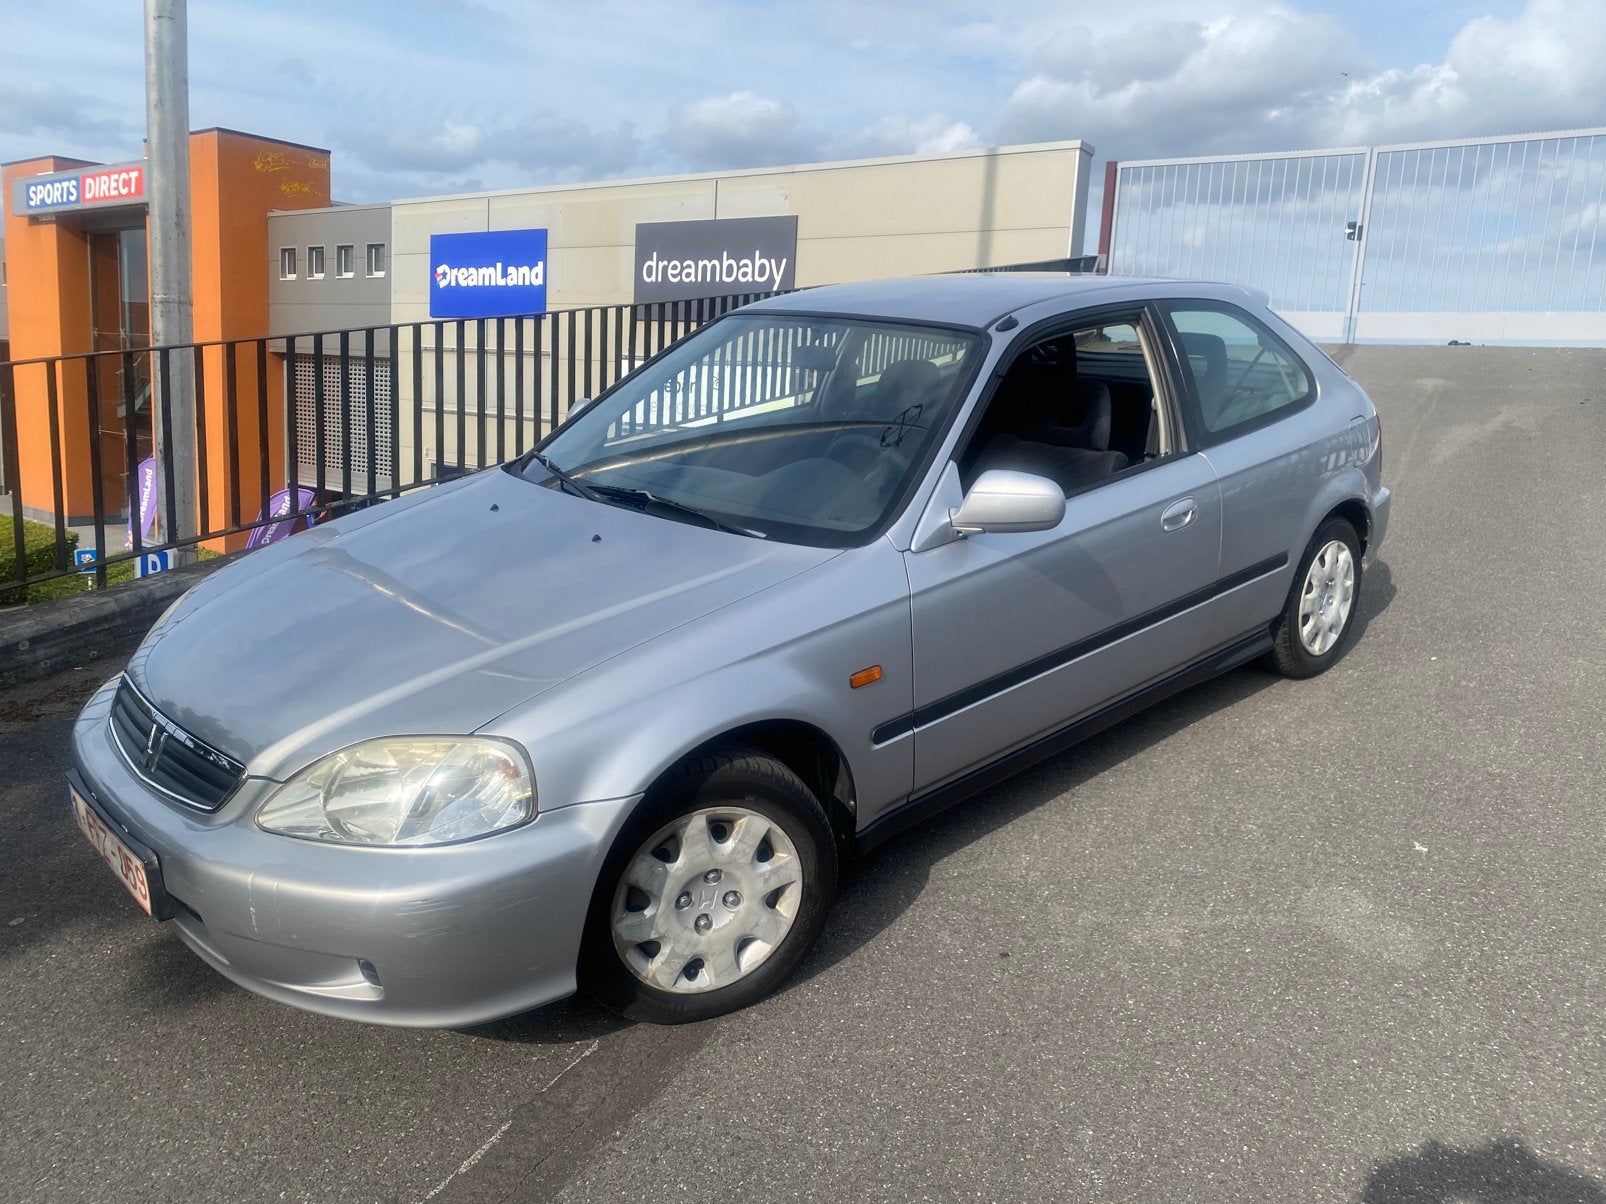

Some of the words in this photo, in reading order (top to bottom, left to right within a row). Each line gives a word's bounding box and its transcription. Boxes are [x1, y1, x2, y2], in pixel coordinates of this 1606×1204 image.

[29, 180, 77, 206] SPORTS
[85, 171, 139, 199] DIRECT
[435, 261, 544, 288] DreamLand
[642, 250, 787, 291] dreambaby
